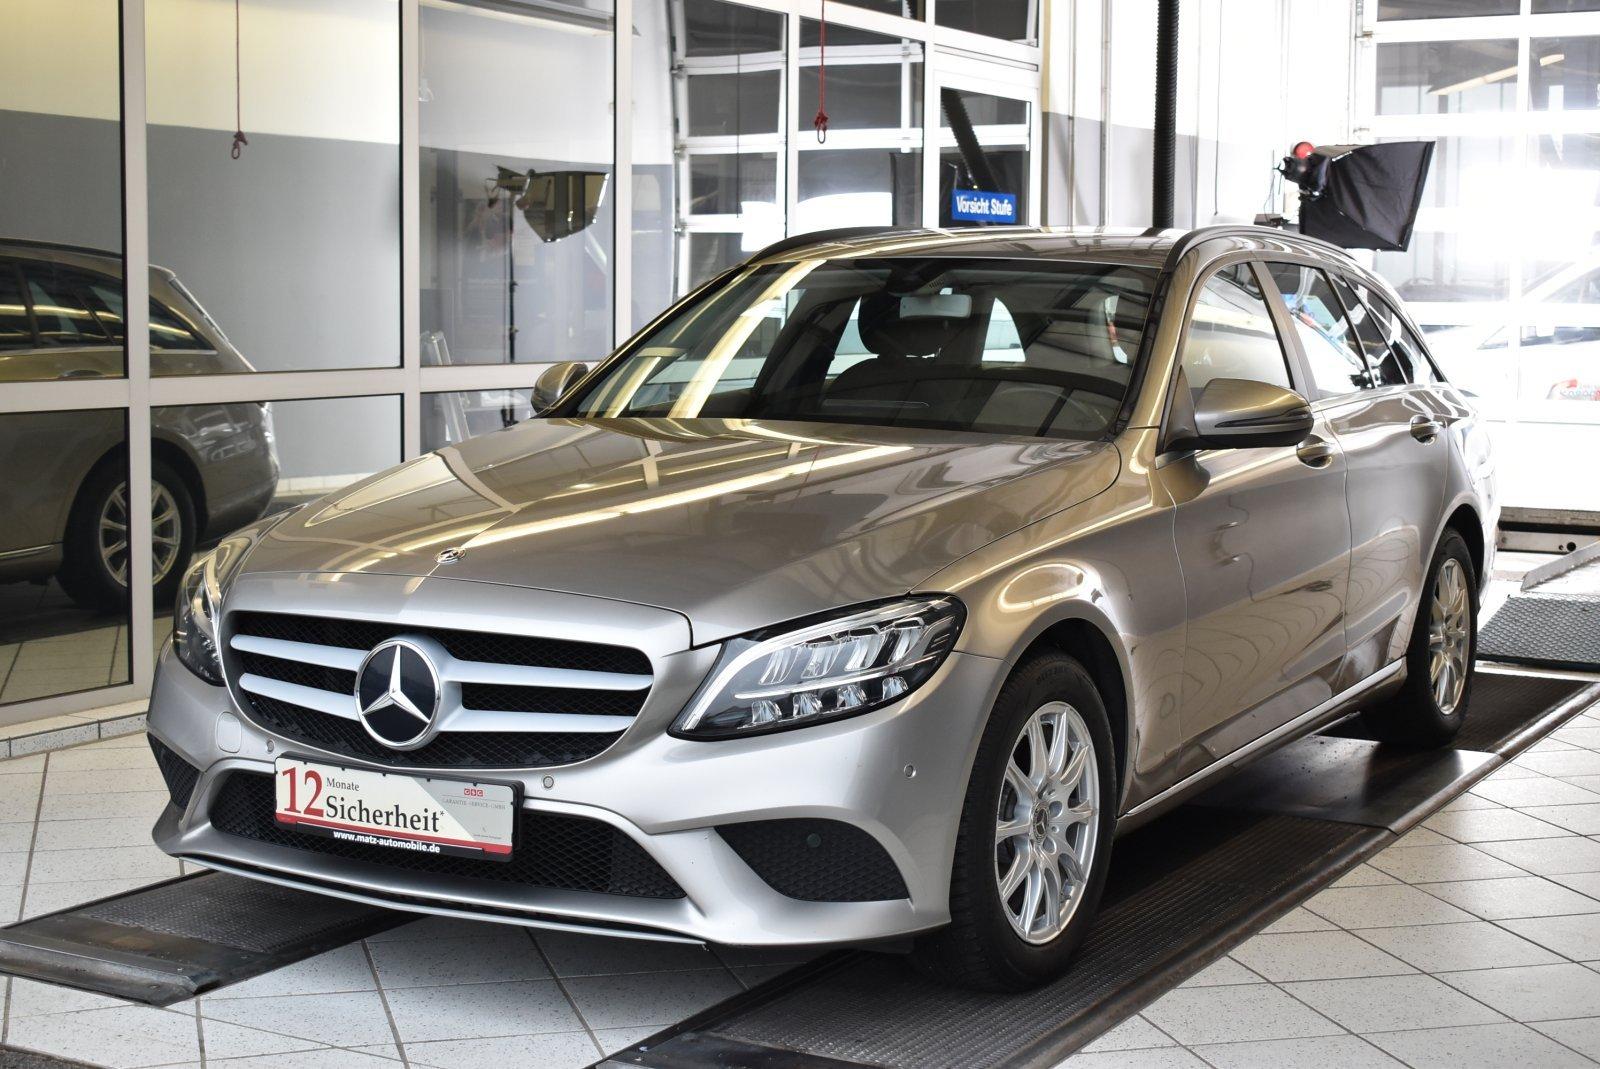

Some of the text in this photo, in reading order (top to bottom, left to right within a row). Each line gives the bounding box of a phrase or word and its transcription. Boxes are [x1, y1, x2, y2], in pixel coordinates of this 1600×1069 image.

[956, 196, 1012, 216] Vorsicht Stufe
[282, 767, 324, 818] 12
[326, 777, 360, 792] Monate
[333, 831, 441, 853] www.matz-automobile.de
